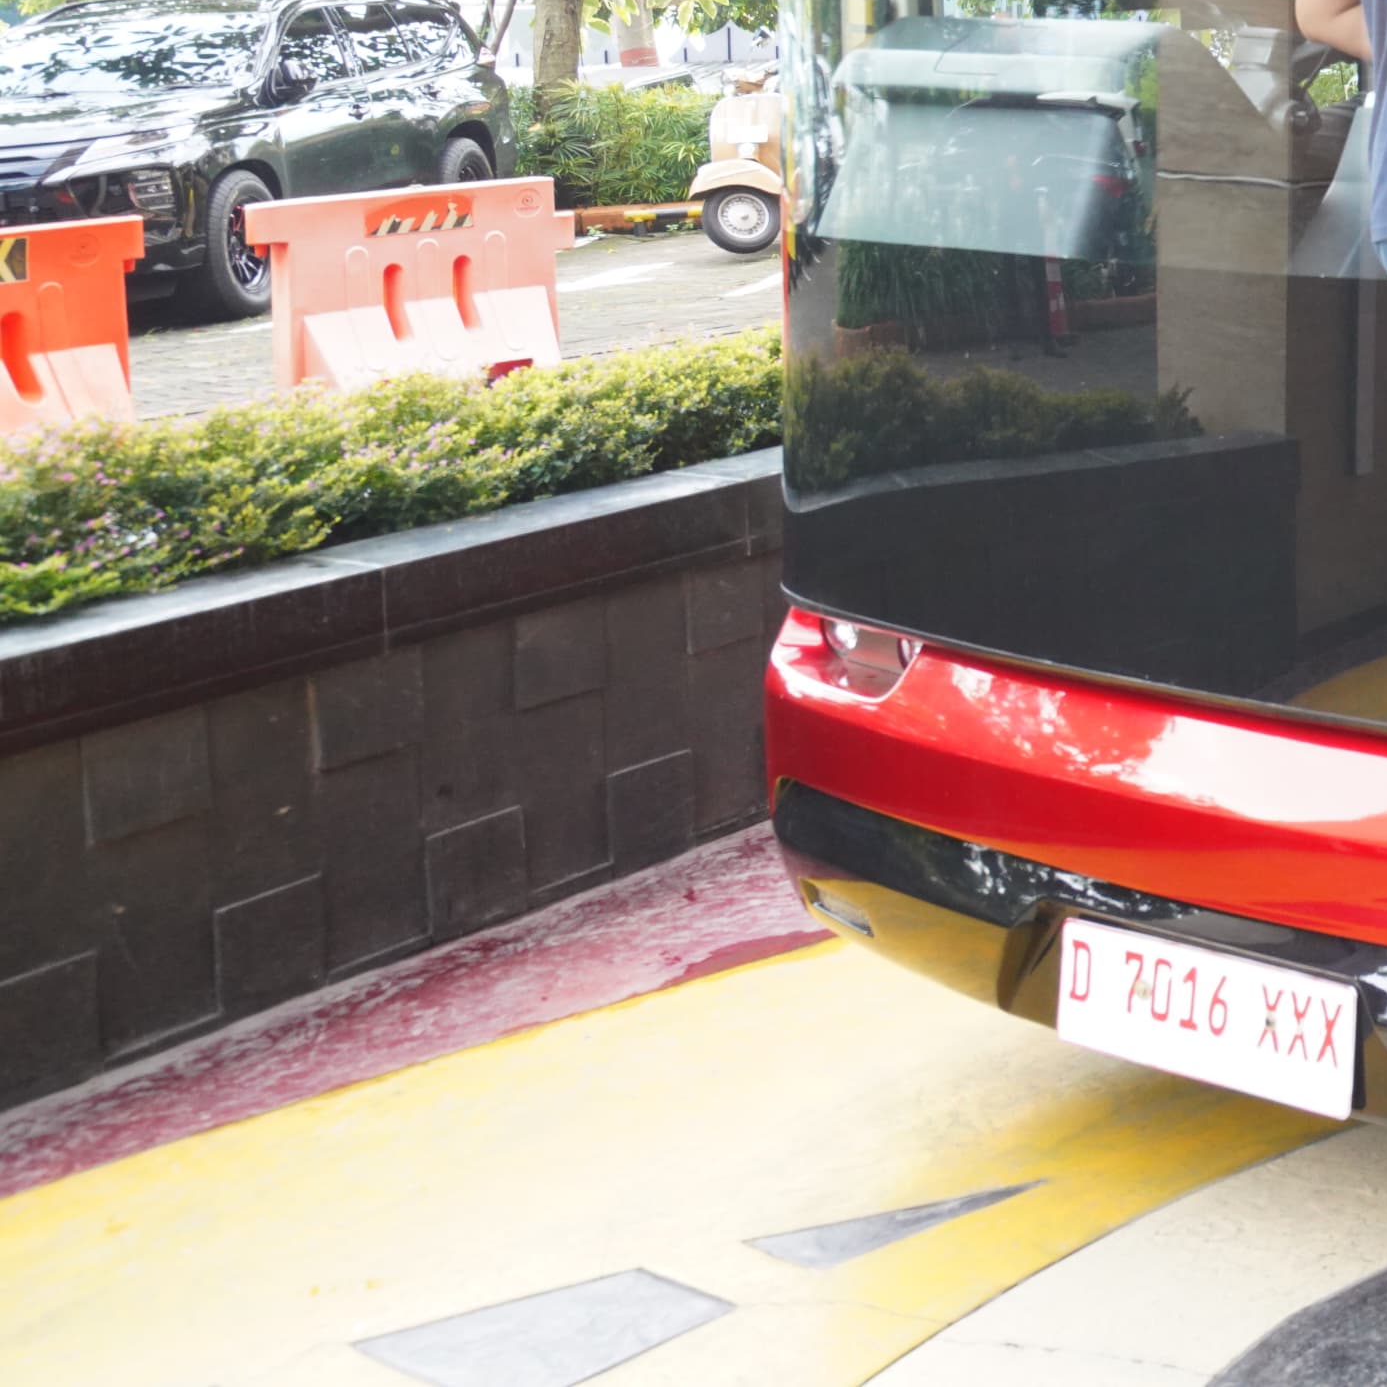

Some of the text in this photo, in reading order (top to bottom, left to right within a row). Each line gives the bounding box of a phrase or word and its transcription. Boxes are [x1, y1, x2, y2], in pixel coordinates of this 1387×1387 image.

[1069, 940, 1342, 1068] D 7016 XXX
